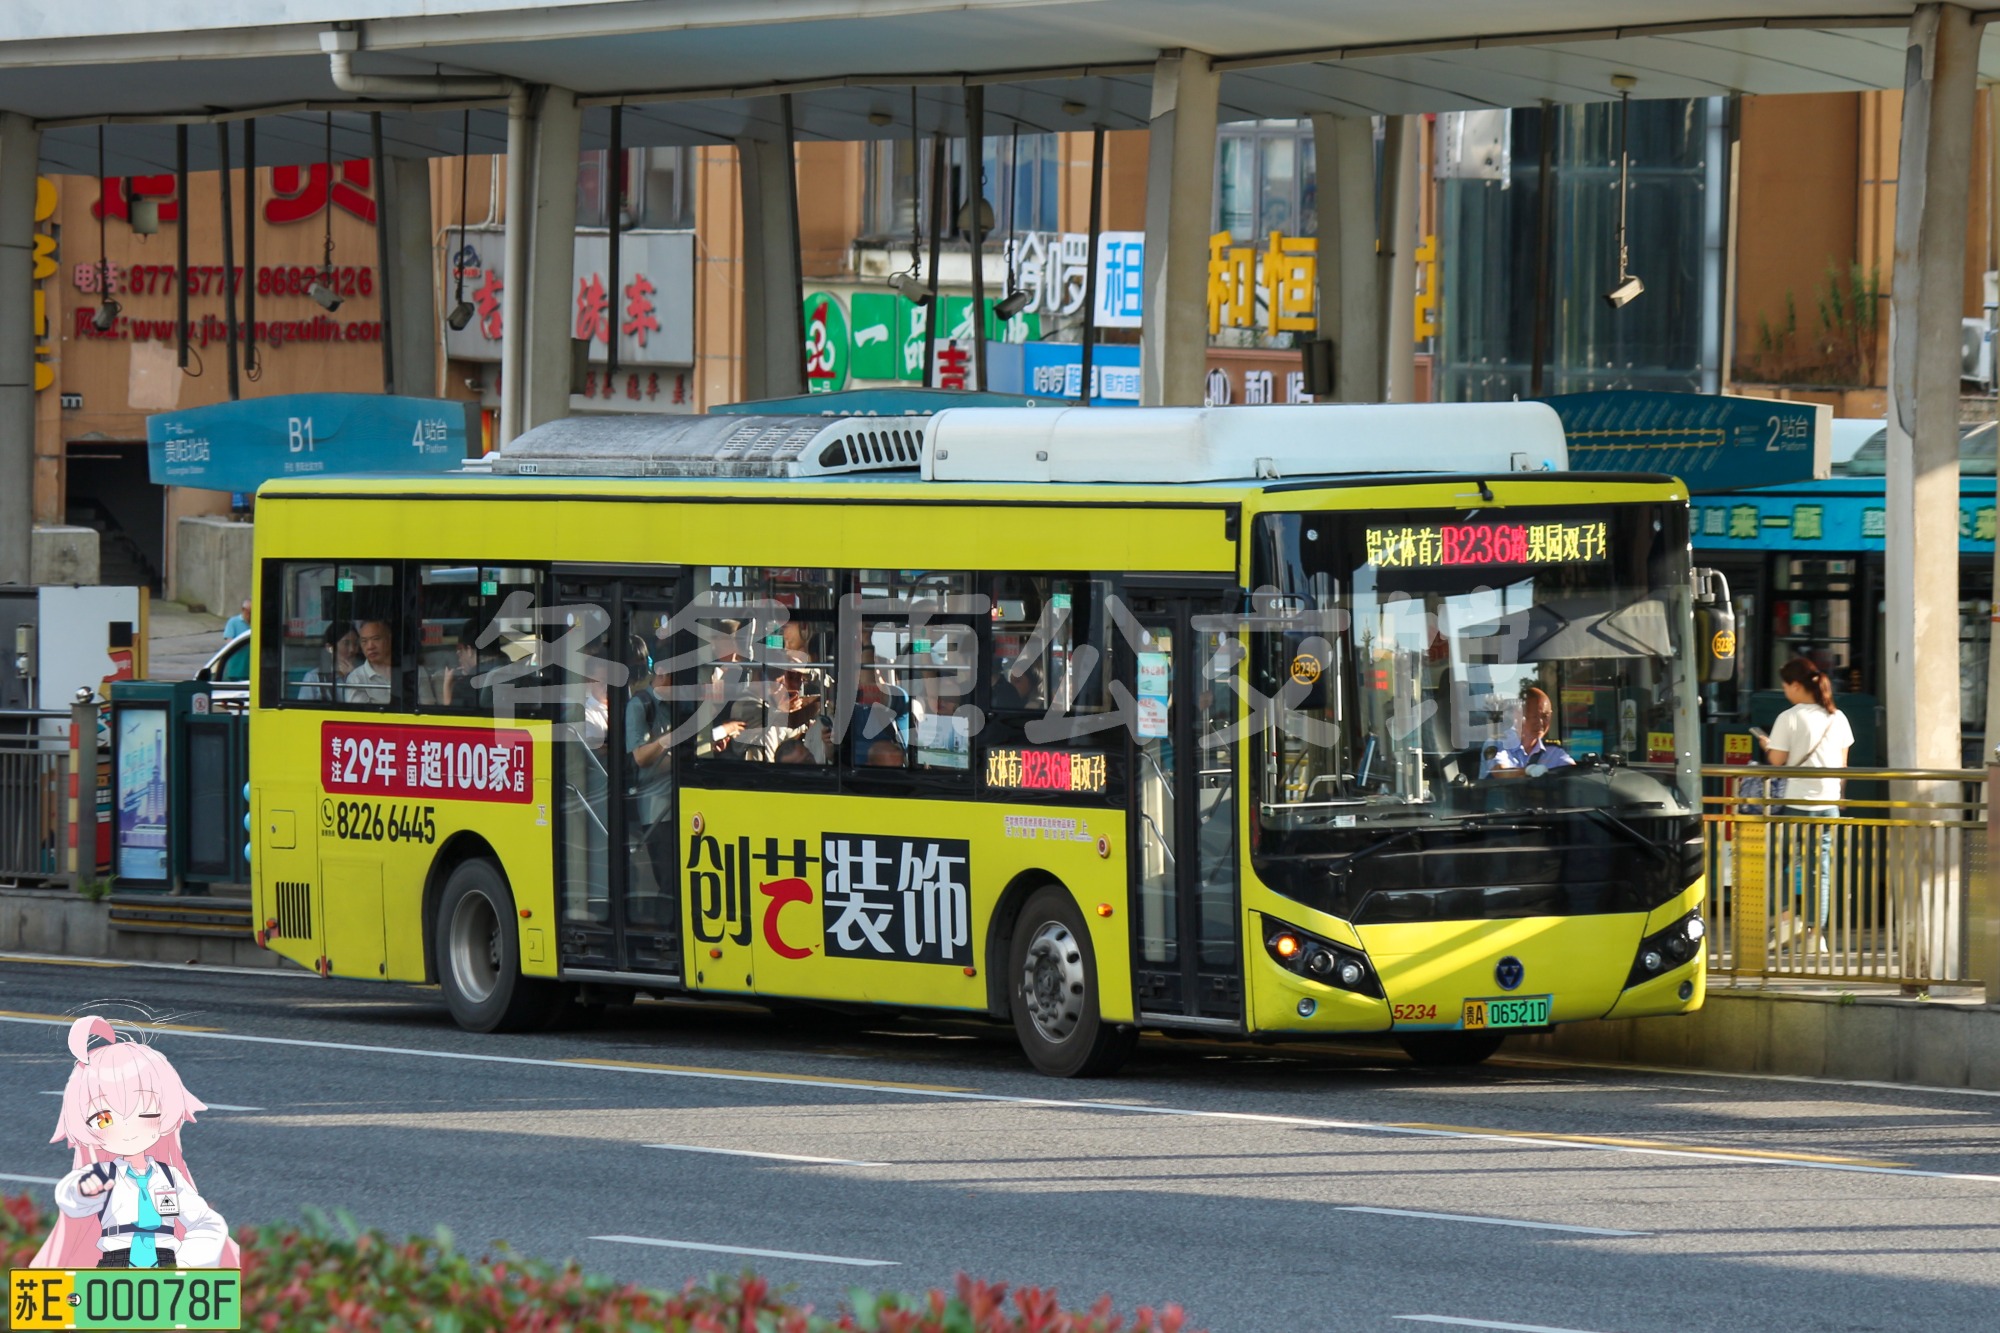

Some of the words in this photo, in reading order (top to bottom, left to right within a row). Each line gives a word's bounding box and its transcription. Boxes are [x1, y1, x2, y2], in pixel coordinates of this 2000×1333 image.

[288, 416, 314, 453] B1
[164, 438, 210, 463] 贵阳北站
[1393, 1004, 1437, 1020] 5234
